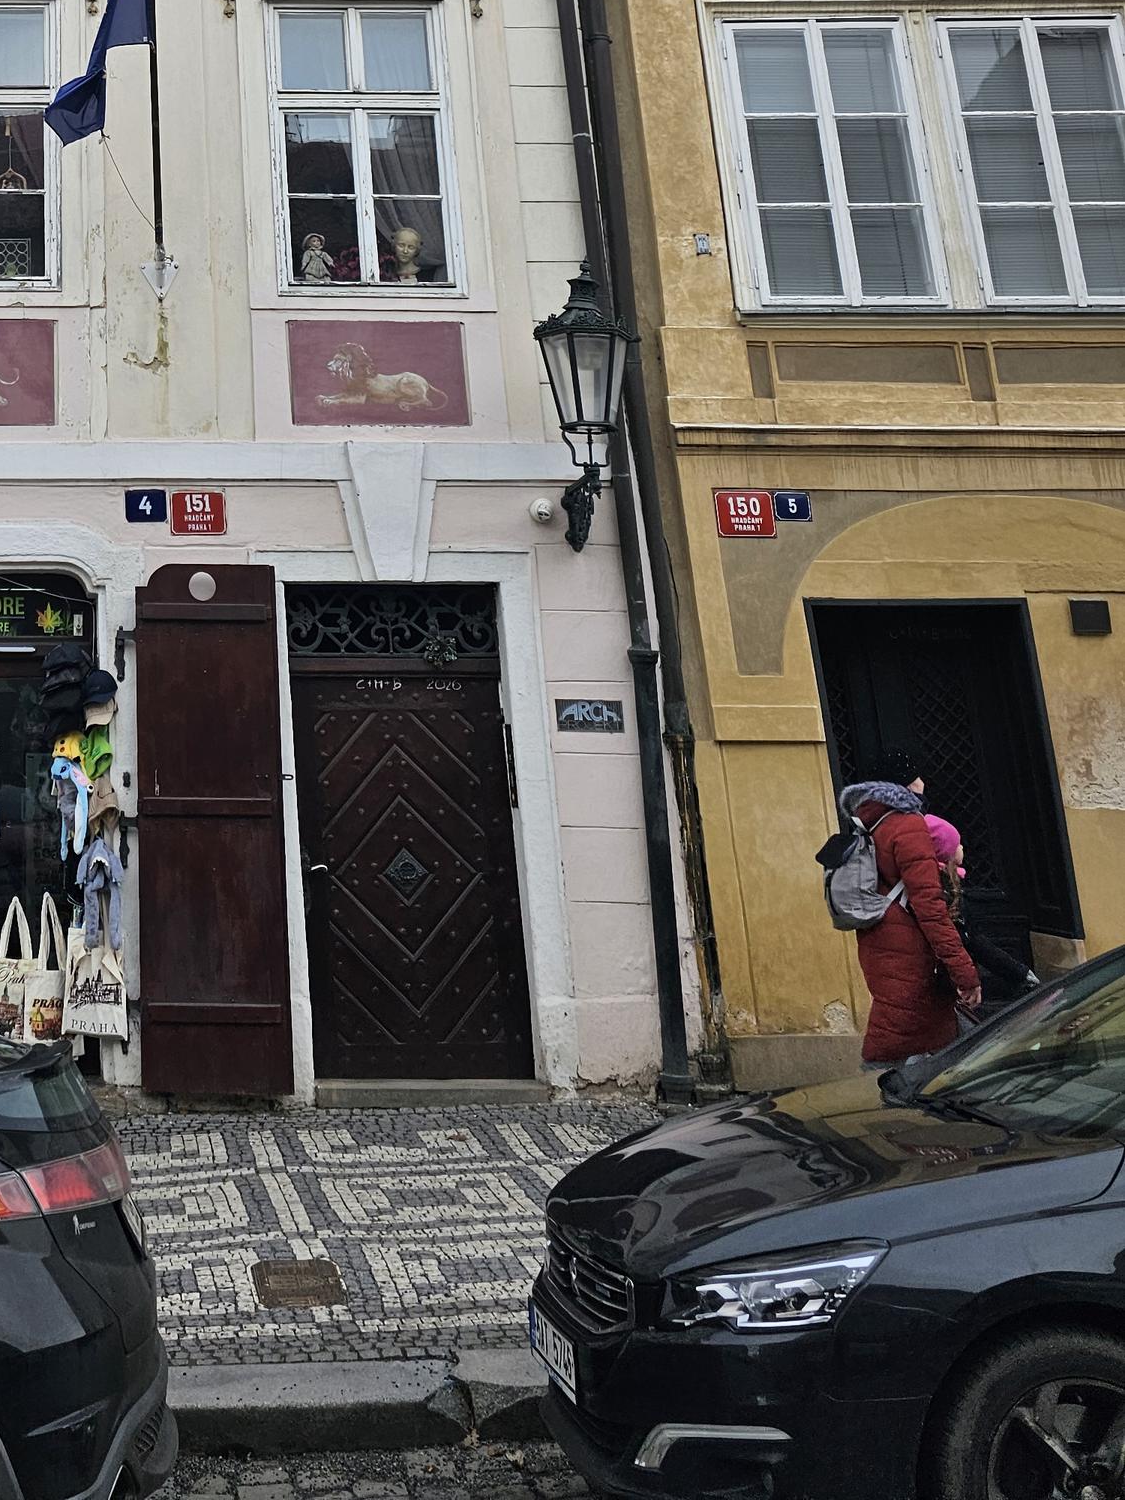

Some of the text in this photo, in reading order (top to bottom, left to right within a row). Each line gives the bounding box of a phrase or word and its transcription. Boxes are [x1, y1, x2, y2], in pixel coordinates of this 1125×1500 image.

[138, 495, 152, 515] 4
[184, 494, 211, 513] 151
[727, 496, 761, 516] 150
[787, 498, 798, 514] 5
[184, 513, 215, 522] HRADČANY
[730, 516, 763, 525] HRADČANY
[71, 1019, 119, 1034] PRAHA
